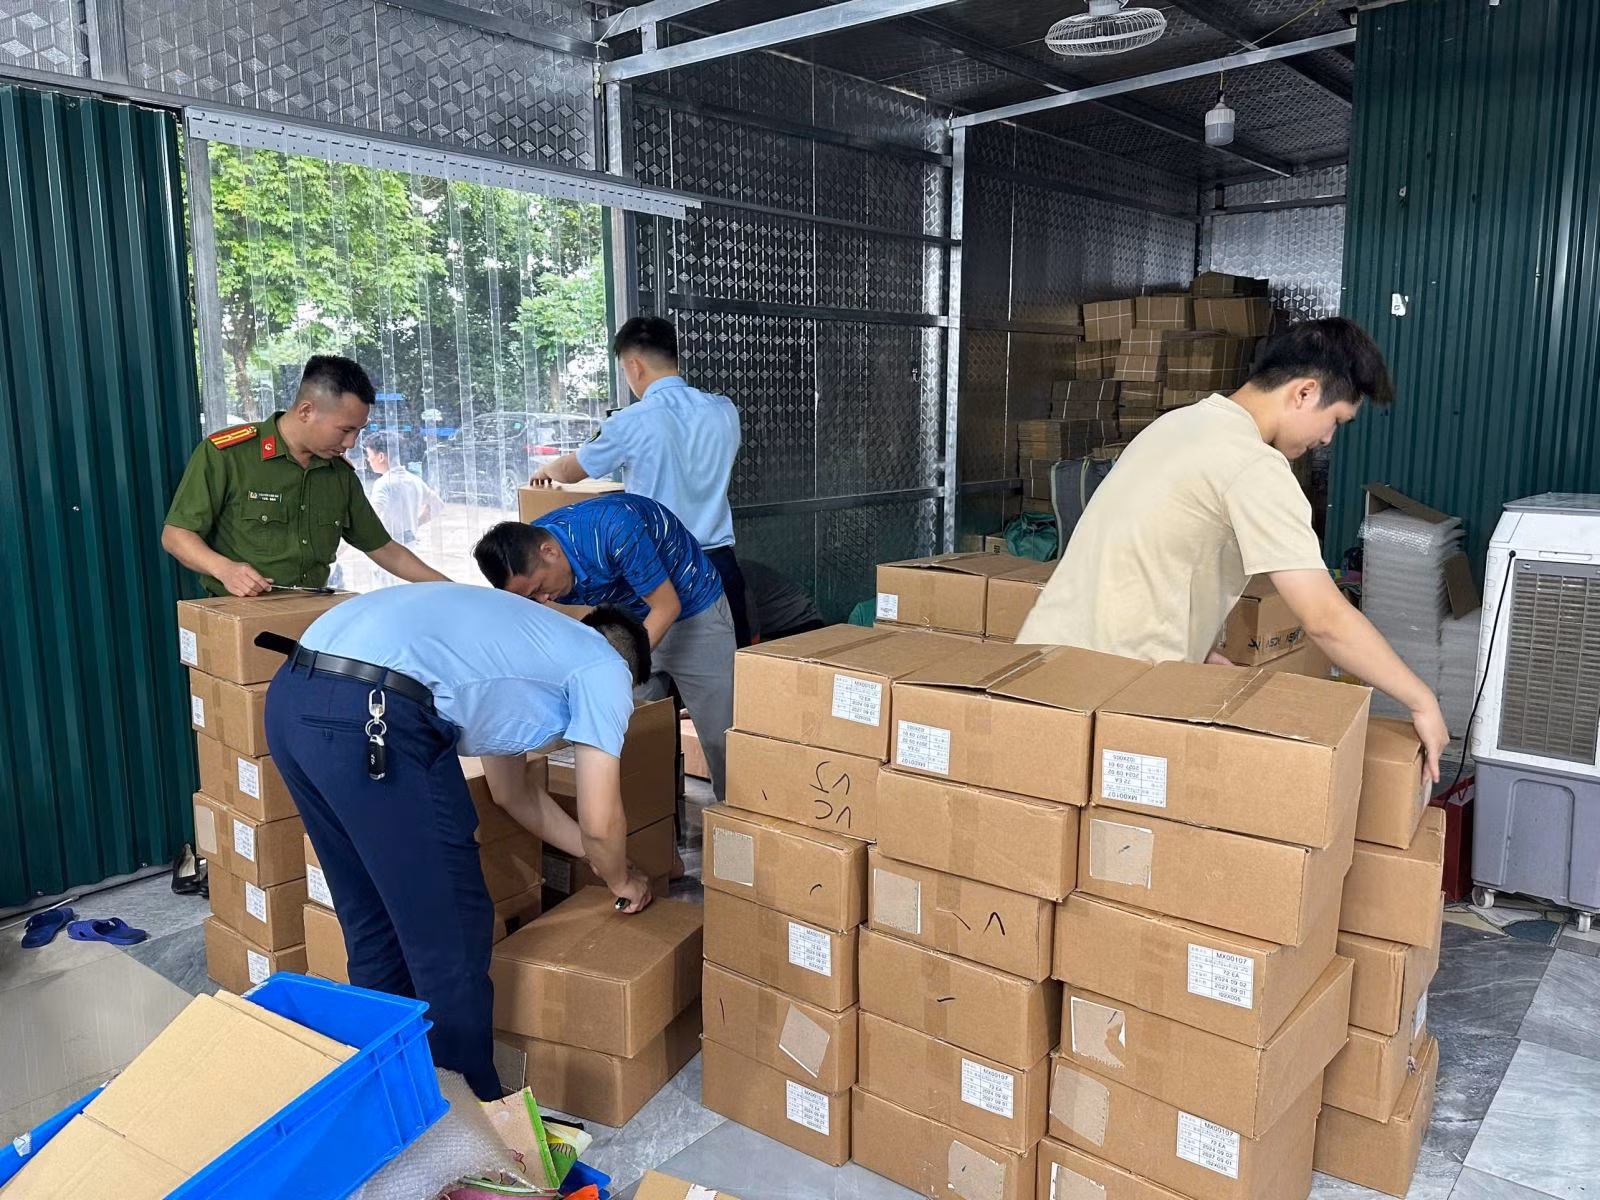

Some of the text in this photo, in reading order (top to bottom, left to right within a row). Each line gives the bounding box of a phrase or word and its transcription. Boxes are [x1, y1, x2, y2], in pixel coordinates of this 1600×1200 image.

[1108, 792, 1137, 800] MX00107
[1216, 952, 1247, 964] MX00107
[1204, 1122, 1234, 1136] MX00107
